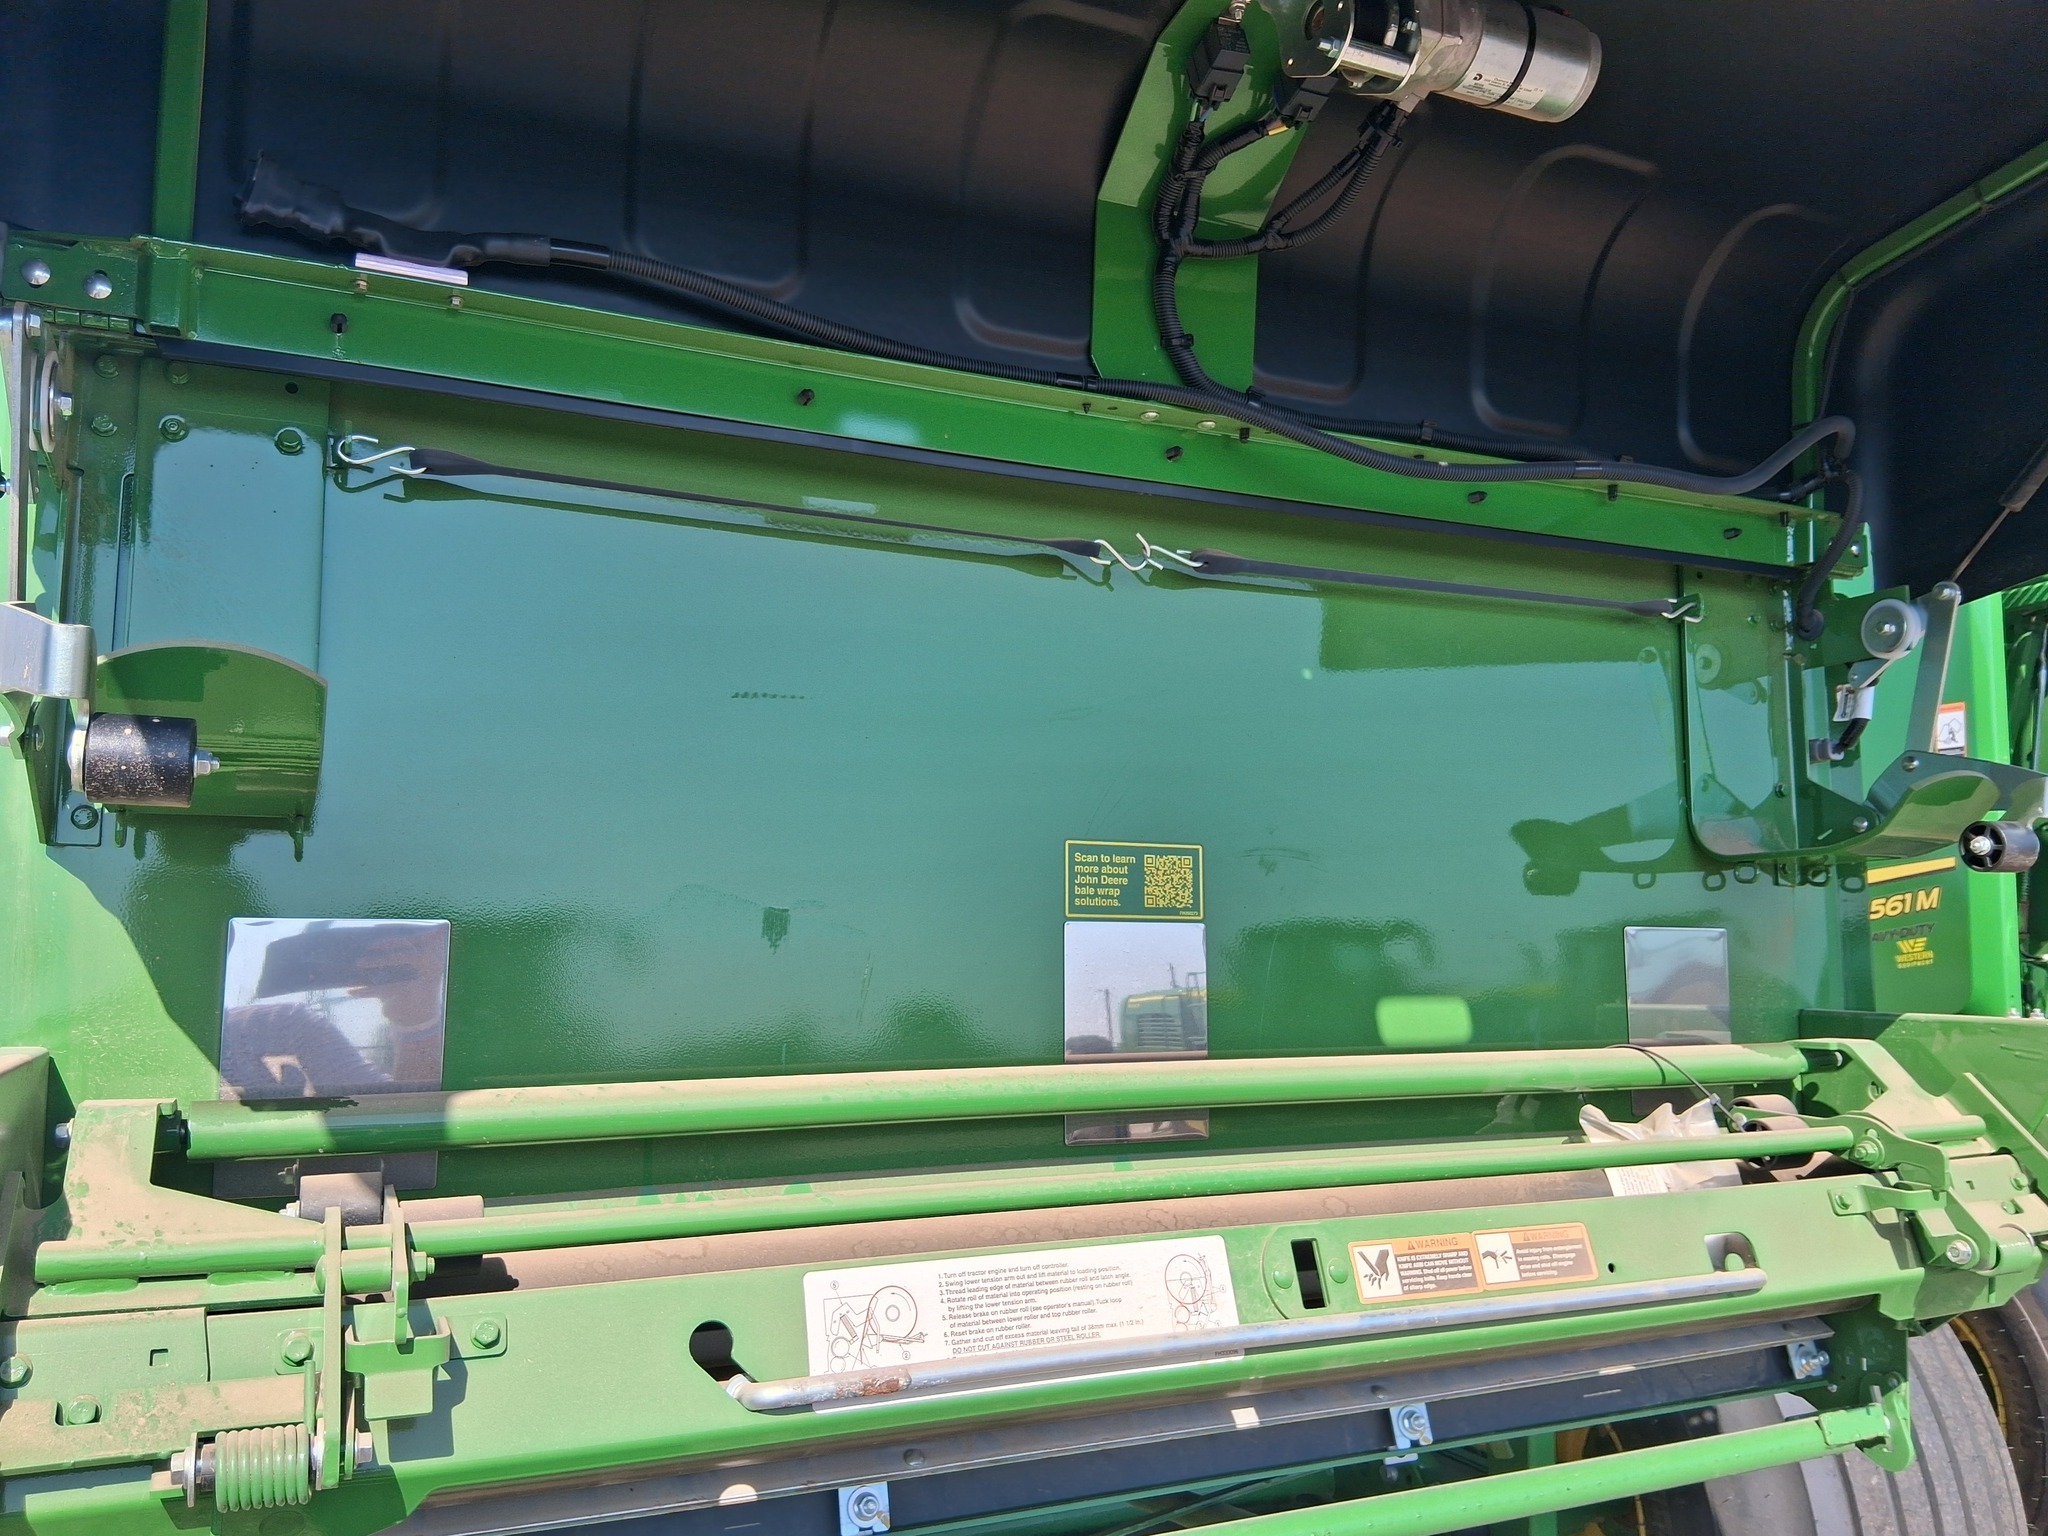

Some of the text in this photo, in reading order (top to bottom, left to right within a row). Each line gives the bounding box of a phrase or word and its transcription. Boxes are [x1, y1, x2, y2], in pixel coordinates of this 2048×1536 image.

[1074, 852, 1136, 864] Scan to learn
[1074, 865, 1128, 874] more about
[1074, 875, 1128, 885] John Deere
[1074, 885, 1121, 897] bale wrap
[1074, 896, 1121, 907] solutions.
[1869, 892, 1913, 920] 561
[1532, 1230, 1569, 1241] WARNING
[1415, 1237, 1458, 1249] WARNING
[1049, 1286, 1072, 1294] position
[1043, 1303, 1071, 1311] operator's
[992, 1341, 1018, 1350] AGAINST
[1019, 1338, 1045, 1347] RUBBER
[1076, 1332, 1101, 1340] ROLLER.
